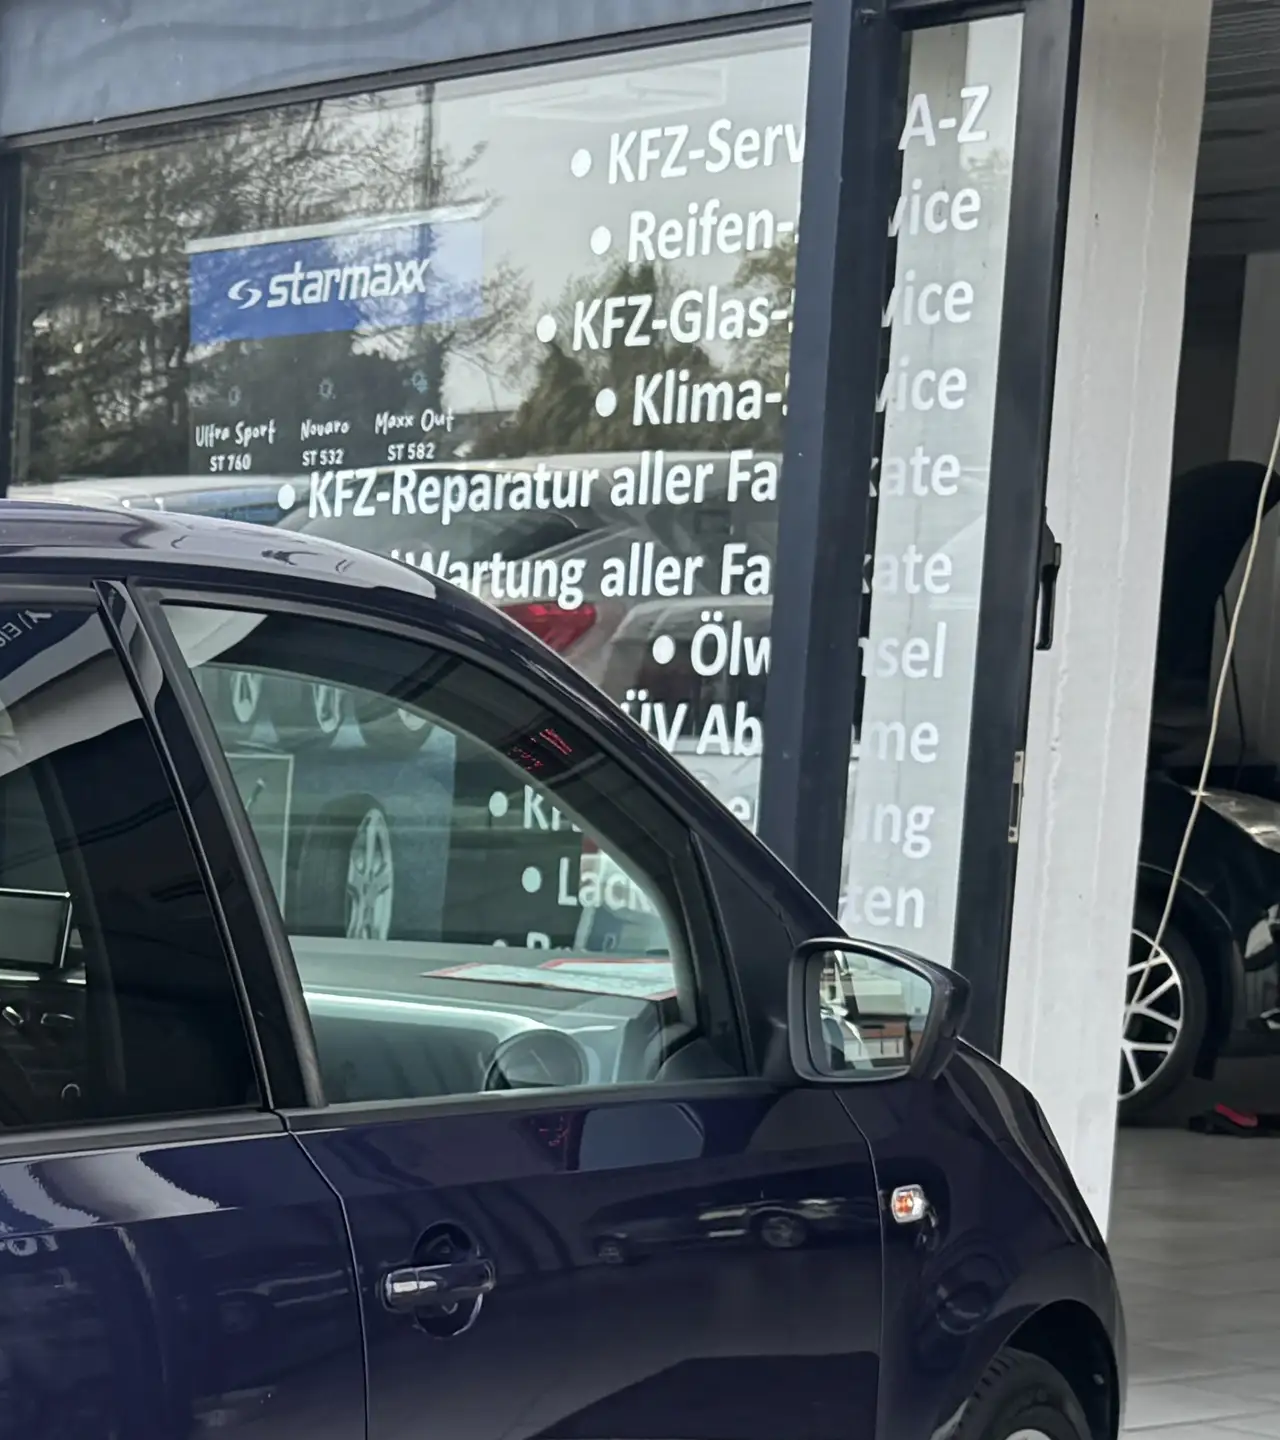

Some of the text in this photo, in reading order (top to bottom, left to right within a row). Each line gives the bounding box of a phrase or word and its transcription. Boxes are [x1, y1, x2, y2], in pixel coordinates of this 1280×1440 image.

[898, 85, 989, 150] A-Z
[266, 259, 431, 308] starmaxx
[235, 418, 277, 448] Sport
[374, 407, 455, 436] Maxx Out
[210, 454, 252, 472] ST 760
[302, 449, 344, 467] ST 532
[388, 442, 436, 461] ST 582
[308, 464, 599, 525] KFZ-Reparatur
[610, 450, 714, 508] aller
[600, 541, 703, 598] aller
